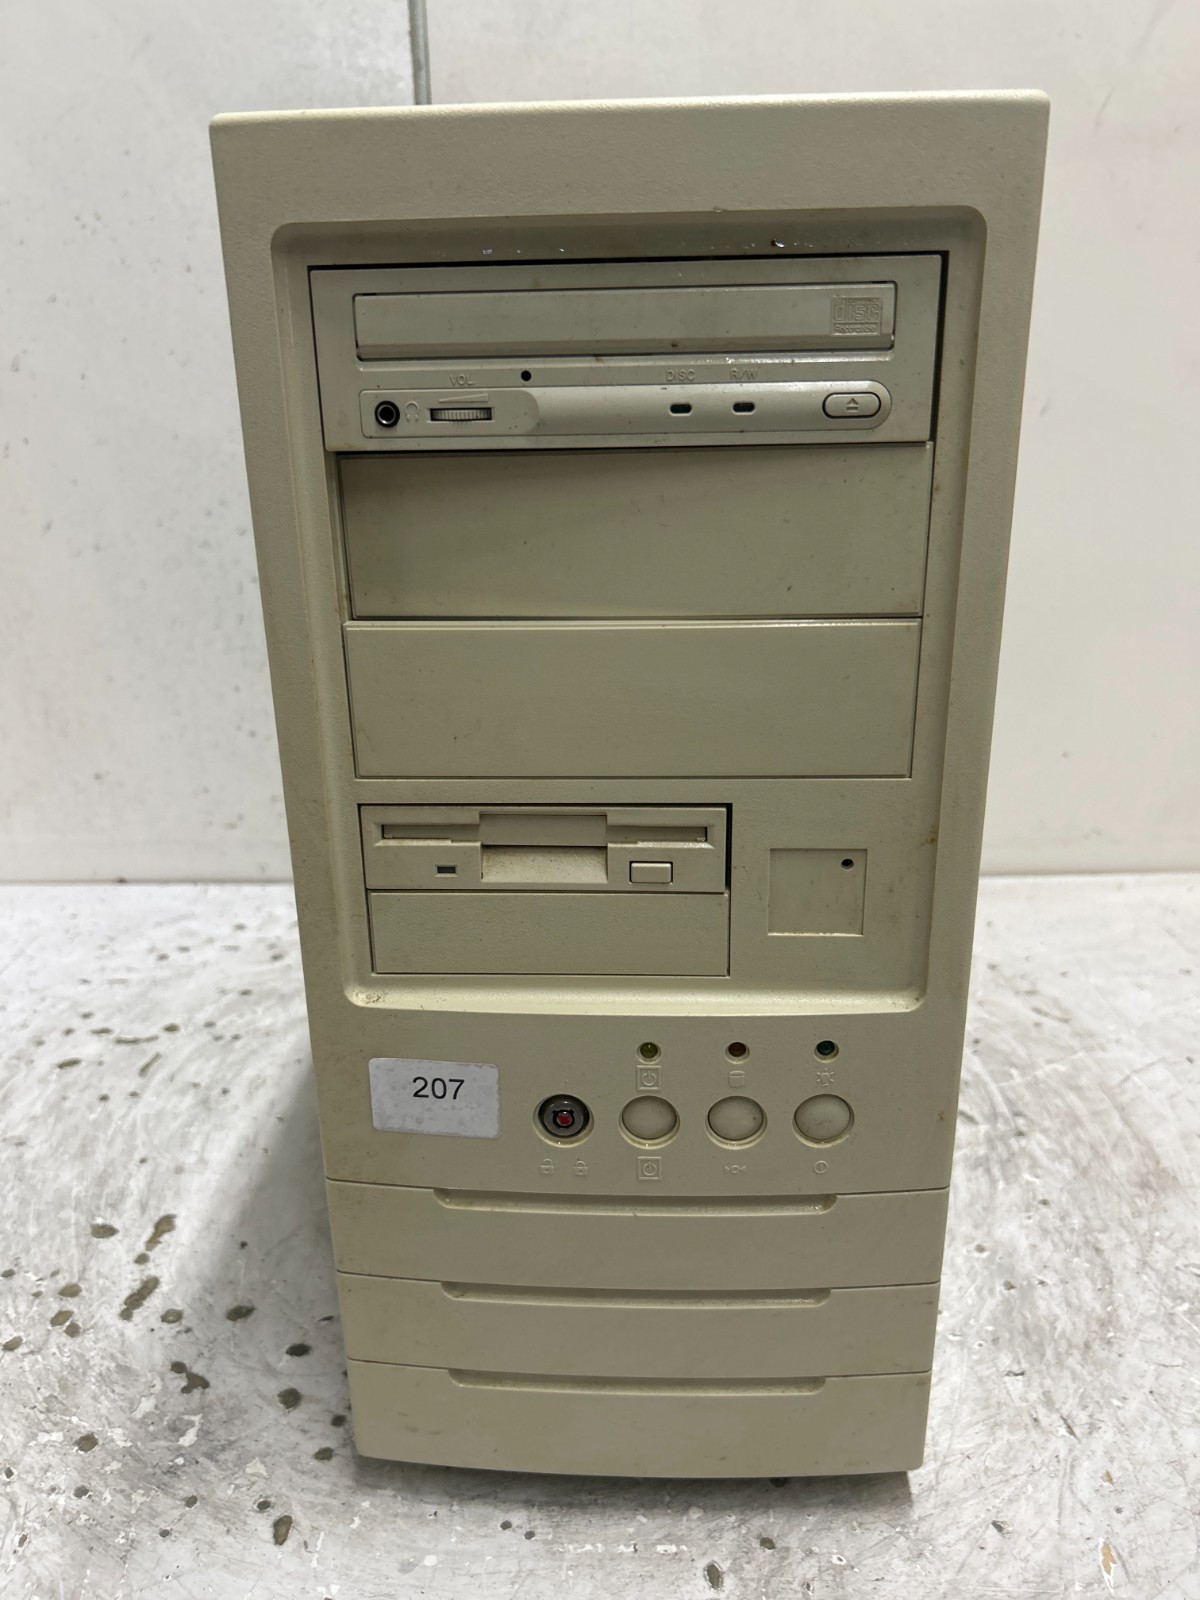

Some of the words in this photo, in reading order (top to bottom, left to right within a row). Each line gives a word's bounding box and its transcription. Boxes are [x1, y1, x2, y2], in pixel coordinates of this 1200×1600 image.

[665, 369, 696, 382] DISC
[730, 367, 758, 380] R/W
[412, 1076, 465, 1100] 207
